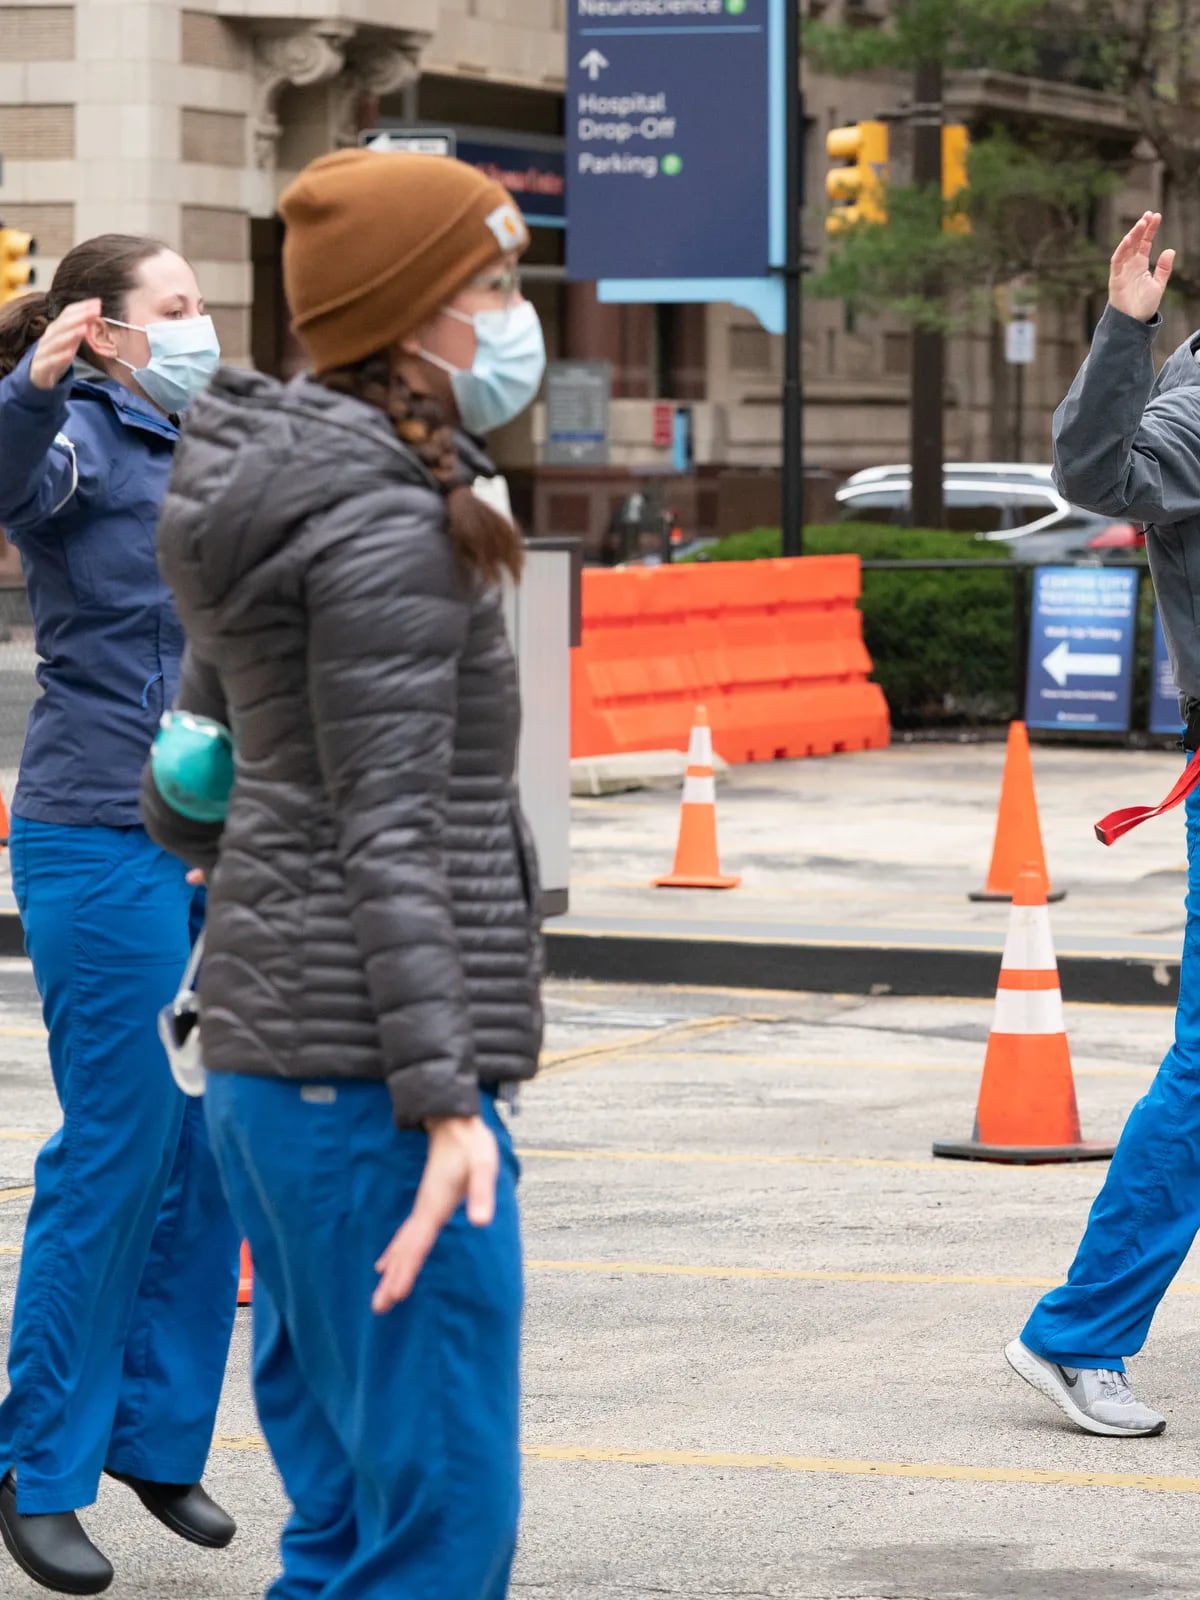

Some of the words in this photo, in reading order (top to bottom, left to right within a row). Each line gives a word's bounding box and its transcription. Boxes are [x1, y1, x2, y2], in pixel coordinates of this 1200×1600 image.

[578, 0, 722, 15] Neuroscience
[578, 93, 666, 117] Hospital
[578, 117, 676, 143] Drop-Off
[578, 152, 658, 178] Parking
